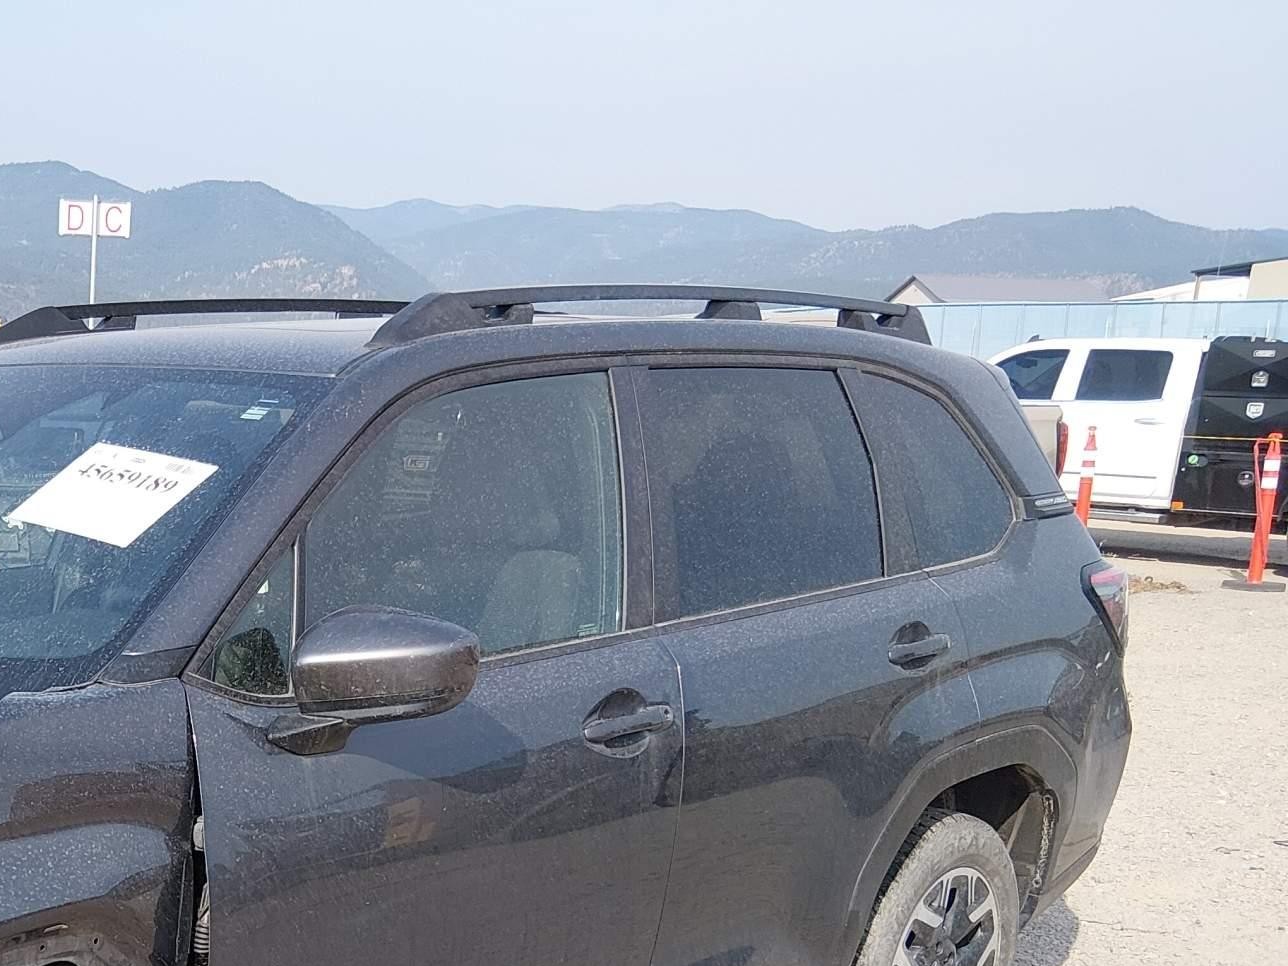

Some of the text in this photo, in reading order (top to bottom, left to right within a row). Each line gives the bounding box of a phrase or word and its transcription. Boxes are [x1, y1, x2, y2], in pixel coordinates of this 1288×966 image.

[67, 204, 84, 231] D
[105, 205, 123, 234] C
[77, 462, 179, 494] 45659189
